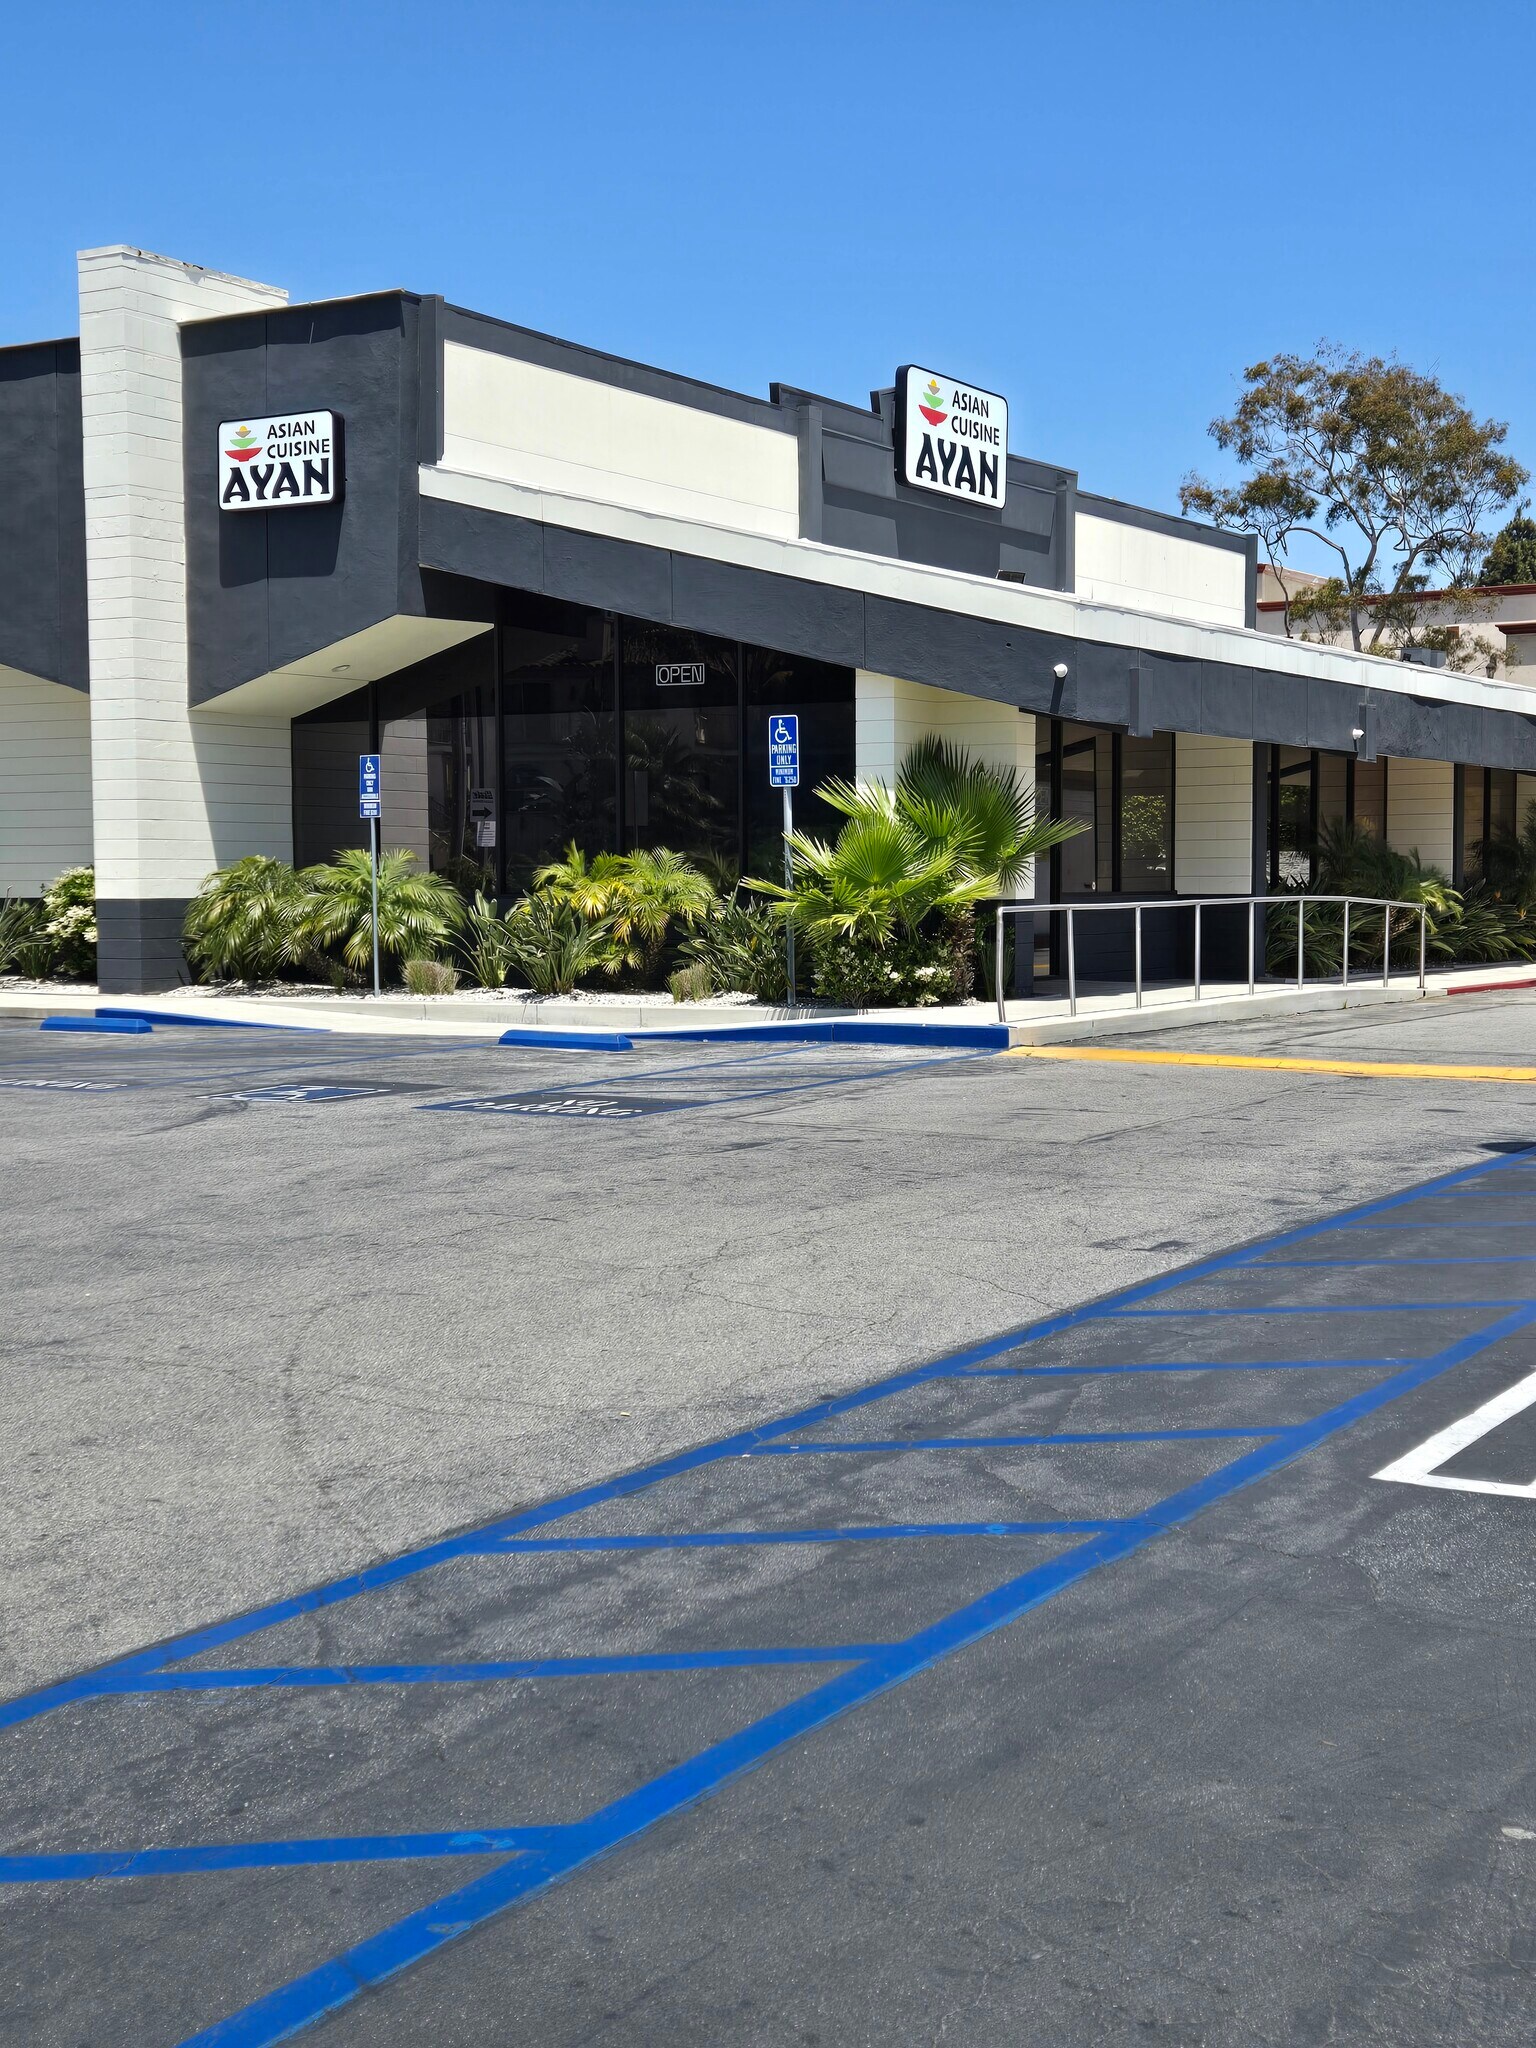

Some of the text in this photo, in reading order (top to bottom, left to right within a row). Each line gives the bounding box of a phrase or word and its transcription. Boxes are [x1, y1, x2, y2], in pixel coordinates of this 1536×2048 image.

[952, 390, 989, 419] ASIAN
[267, 420, 315, 439] ASIAN
[951, 416, 1000, 446] CUISINE
[267, 438, 330, 459] CUISINE
[915, 432, 999, 499] AYAN
[223, 458, 330, 504] AYAN
[658, 665, 702, 684] OPEN
[772, 743, 796, 754] PARKING
[776, 755, 792, 765] ONLY
[449, 1101, 643, 1116] PARKING
